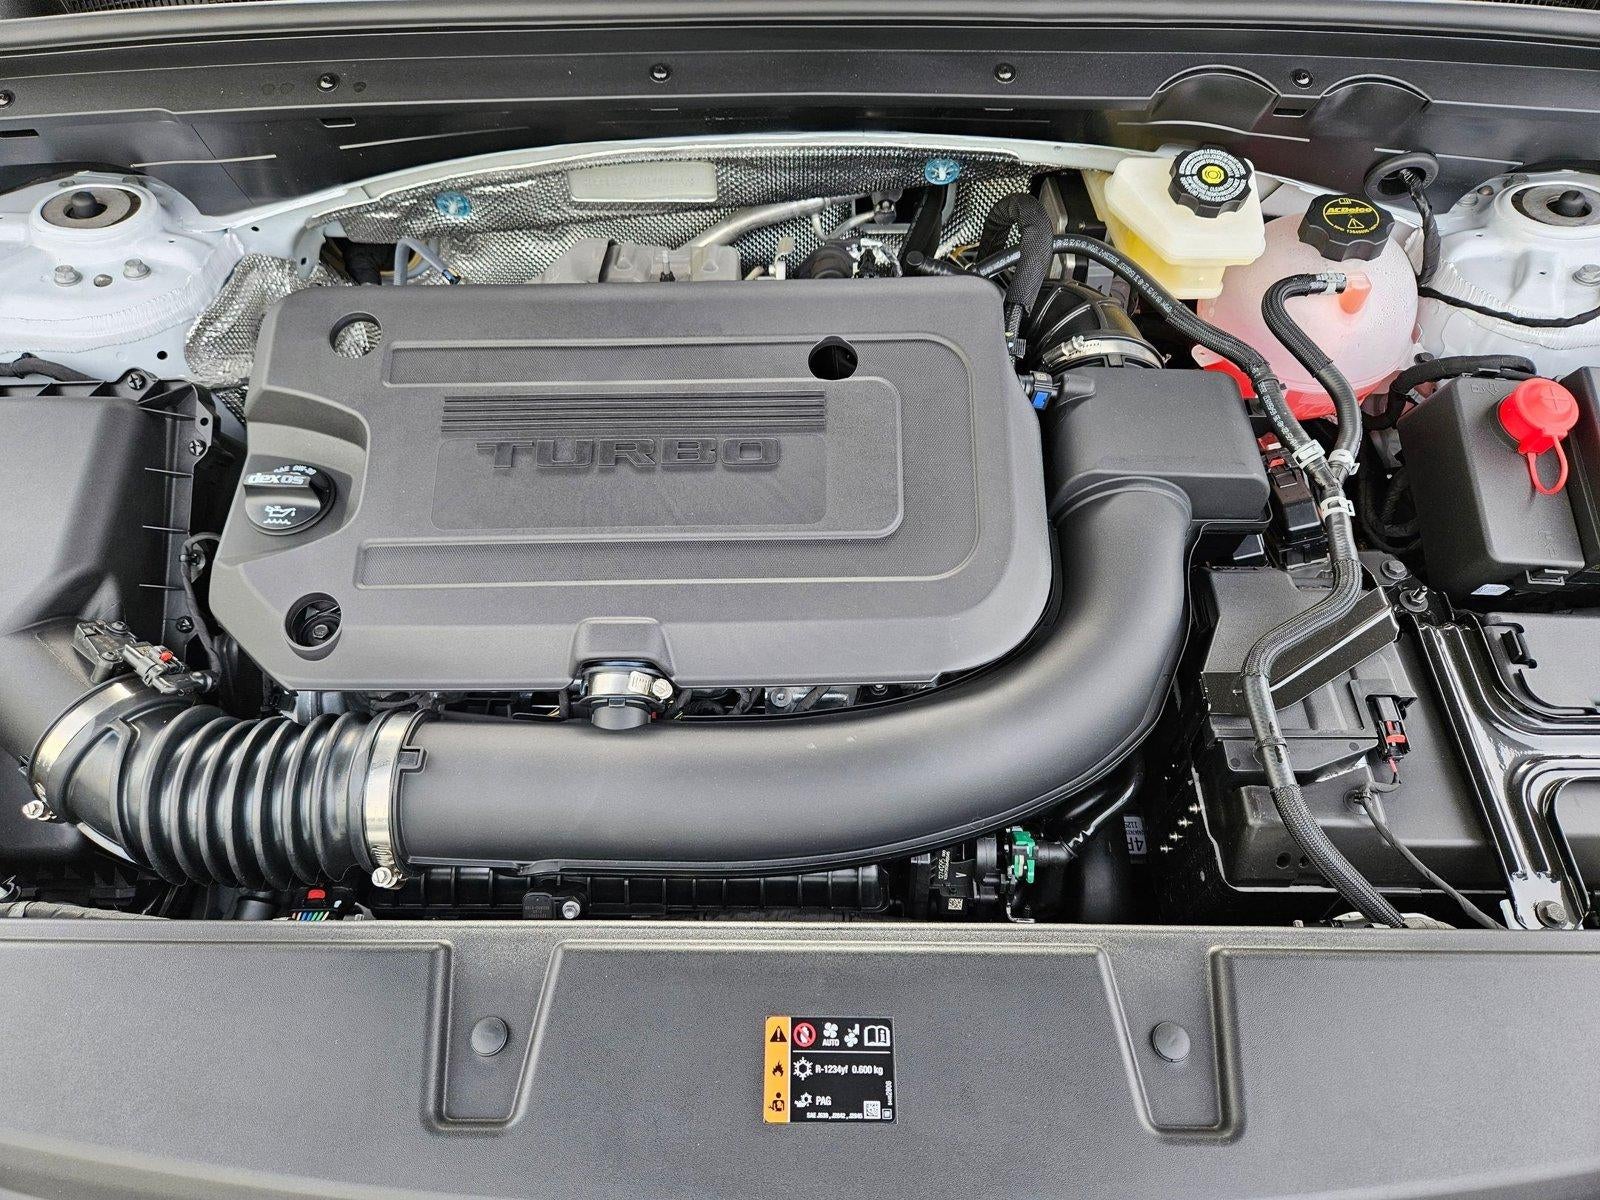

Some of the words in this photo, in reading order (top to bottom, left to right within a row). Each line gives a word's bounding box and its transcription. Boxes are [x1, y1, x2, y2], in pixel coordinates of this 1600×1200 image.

[1325, 206, 1373, 215] ACDelco
[476, 436, 782, 469] TURBO
[247, 472, 305, 485] dexos
[822, 1039, 840, 1047] AUTO
[815, 1064, 849, 1076] R-1234yf
[851, 1065, 873, 1075] 0.600
[873, 1065, 884, 1076] kg
[815, 1095, 832, 1106] PAG
